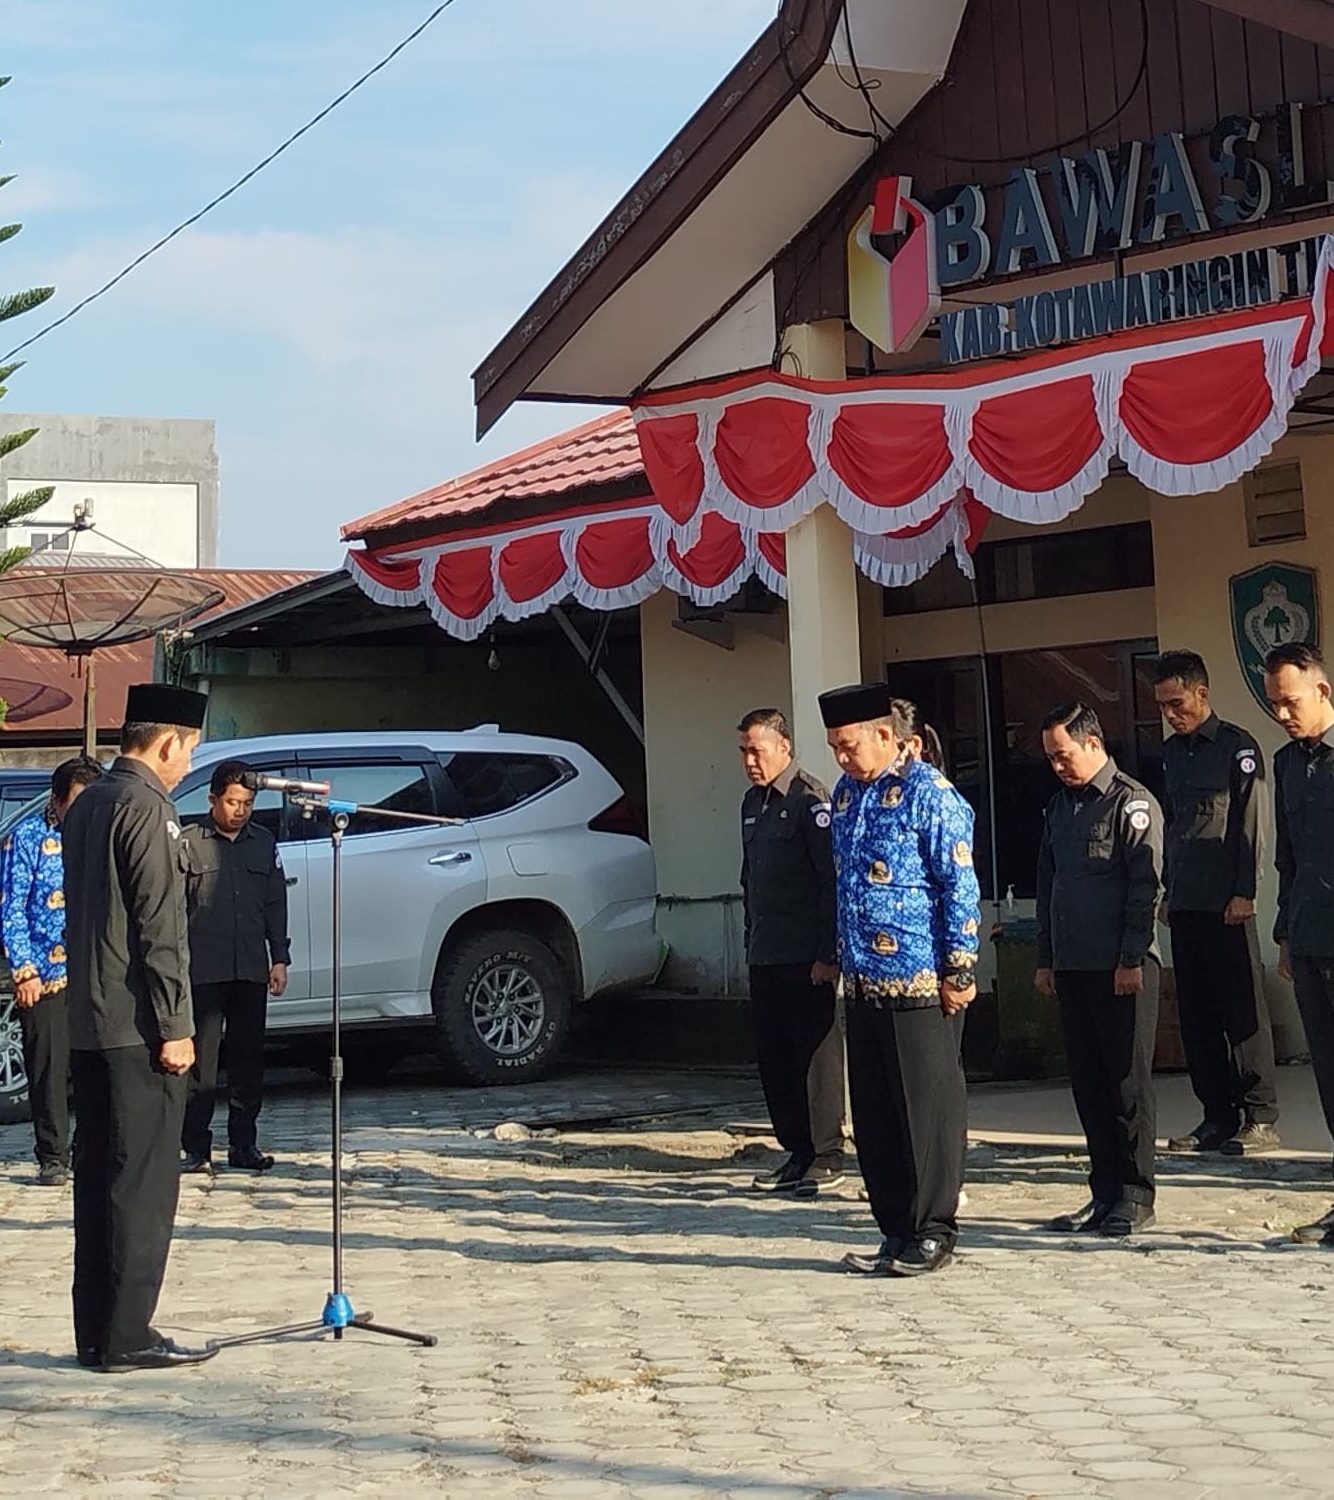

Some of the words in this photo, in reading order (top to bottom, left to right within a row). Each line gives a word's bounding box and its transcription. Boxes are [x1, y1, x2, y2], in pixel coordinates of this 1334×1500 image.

[939, 303, 1017, 365] KAB.
[1015, 248, 1280, 352] KOTAWARINGIN
[495, 1043, 545, 1067] RADIAL
